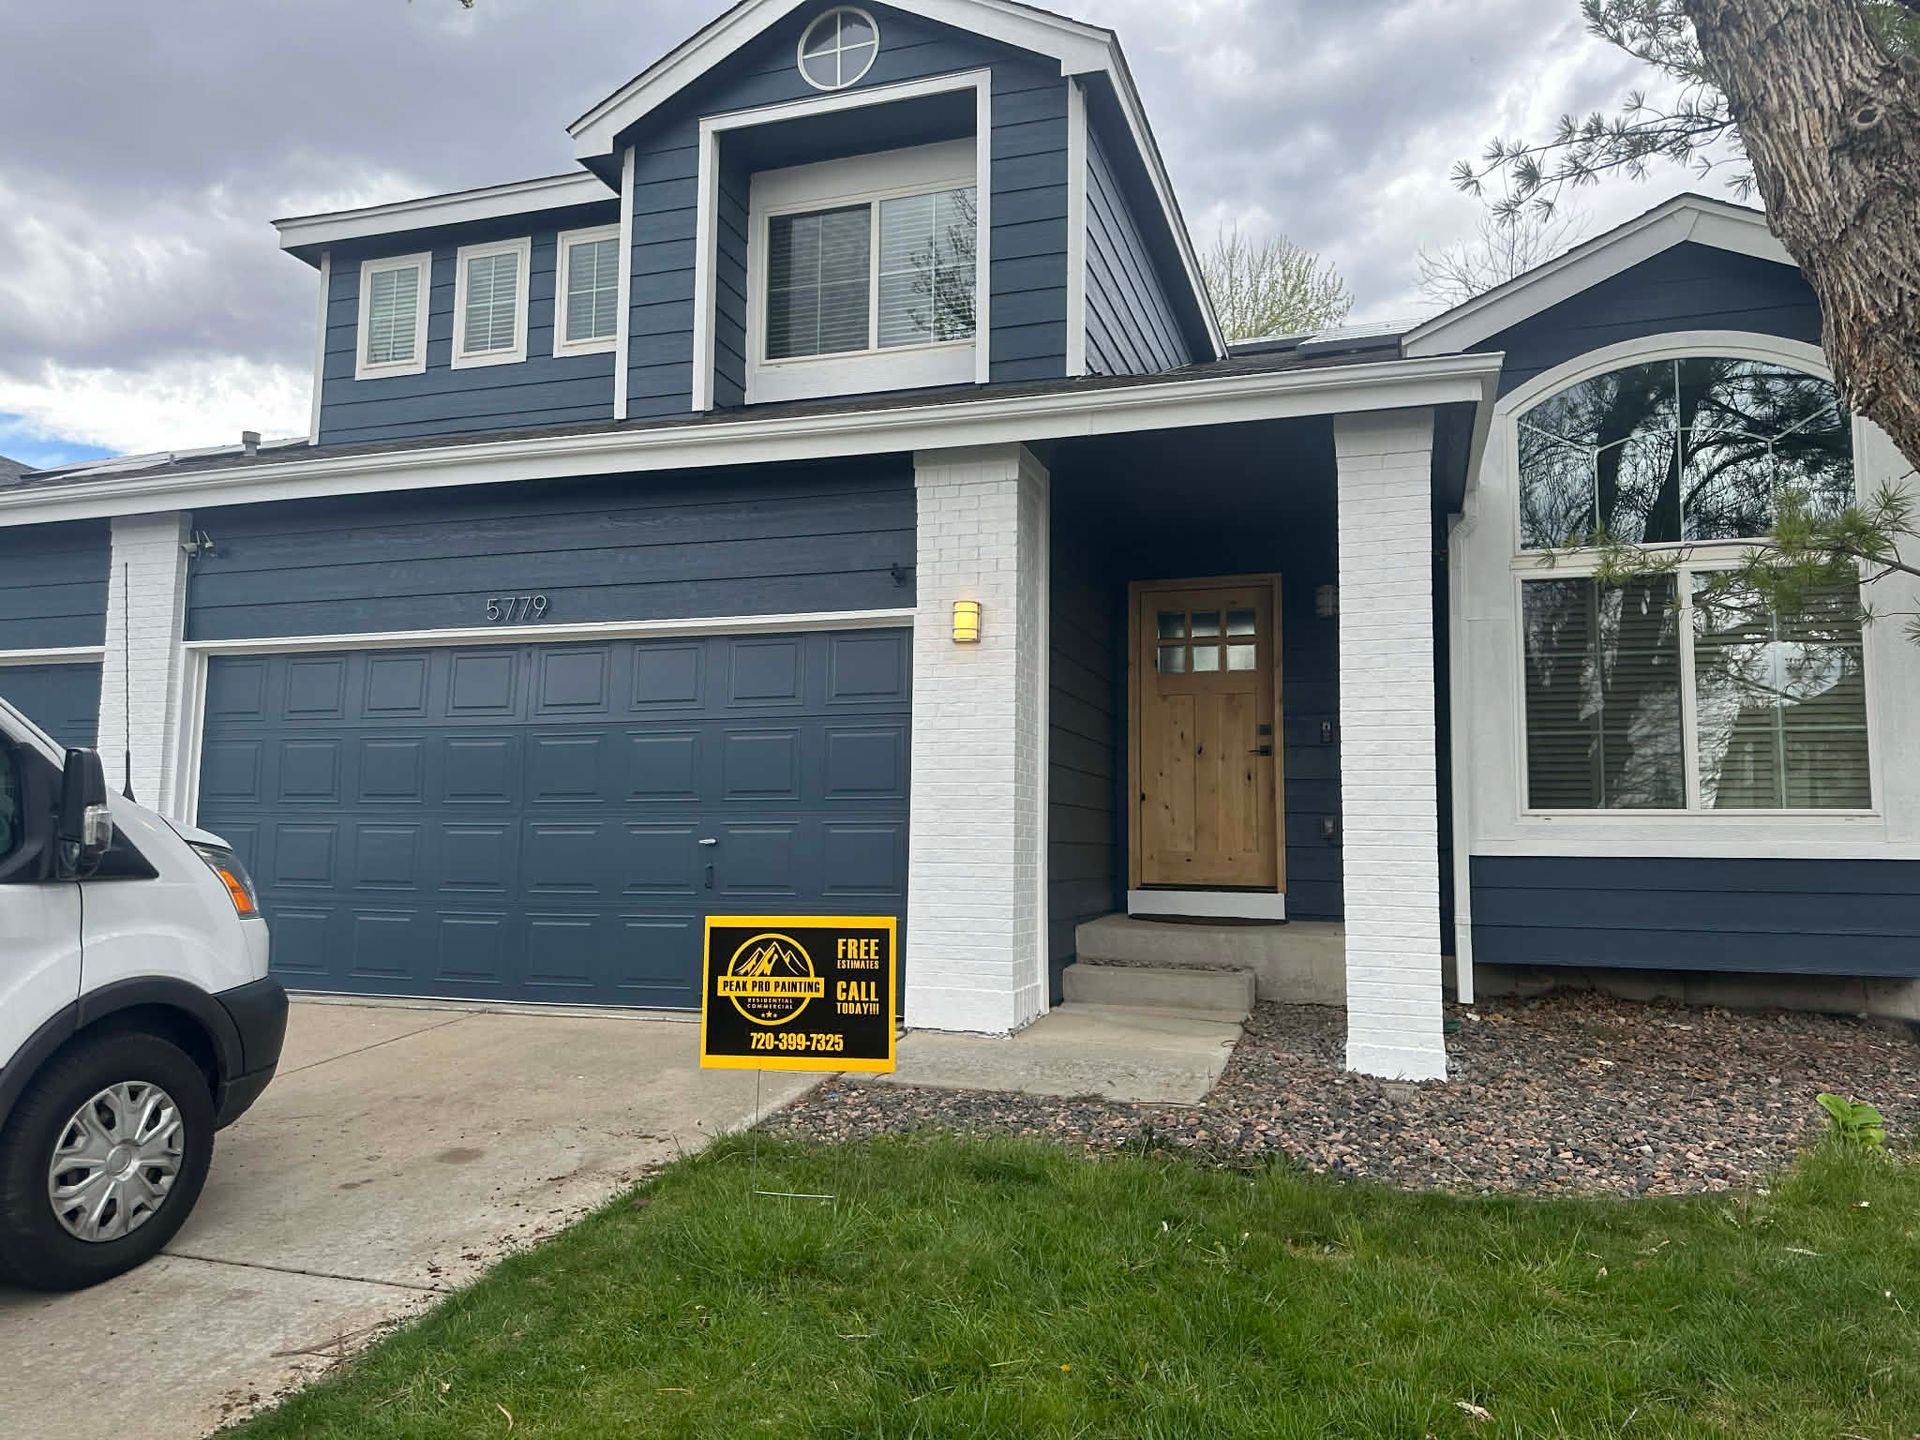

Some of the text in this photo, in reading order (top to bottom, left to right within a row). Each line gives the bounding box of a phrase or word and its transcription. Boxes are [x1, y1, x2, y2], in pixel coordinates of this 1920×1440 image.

[486, 595, 547, 621] 5779
[837, 938, 880, 960] FREE
[837, 959, 880, 970] ESTIMATES
[723, 980, 820, 994] PEAK PRO PAINTING
[836, 980, 879, 1002] CALL
[836, 1002, 880, 1015] TODAY!!!
[750, 1032, 844, 1052] 720-399-7325
